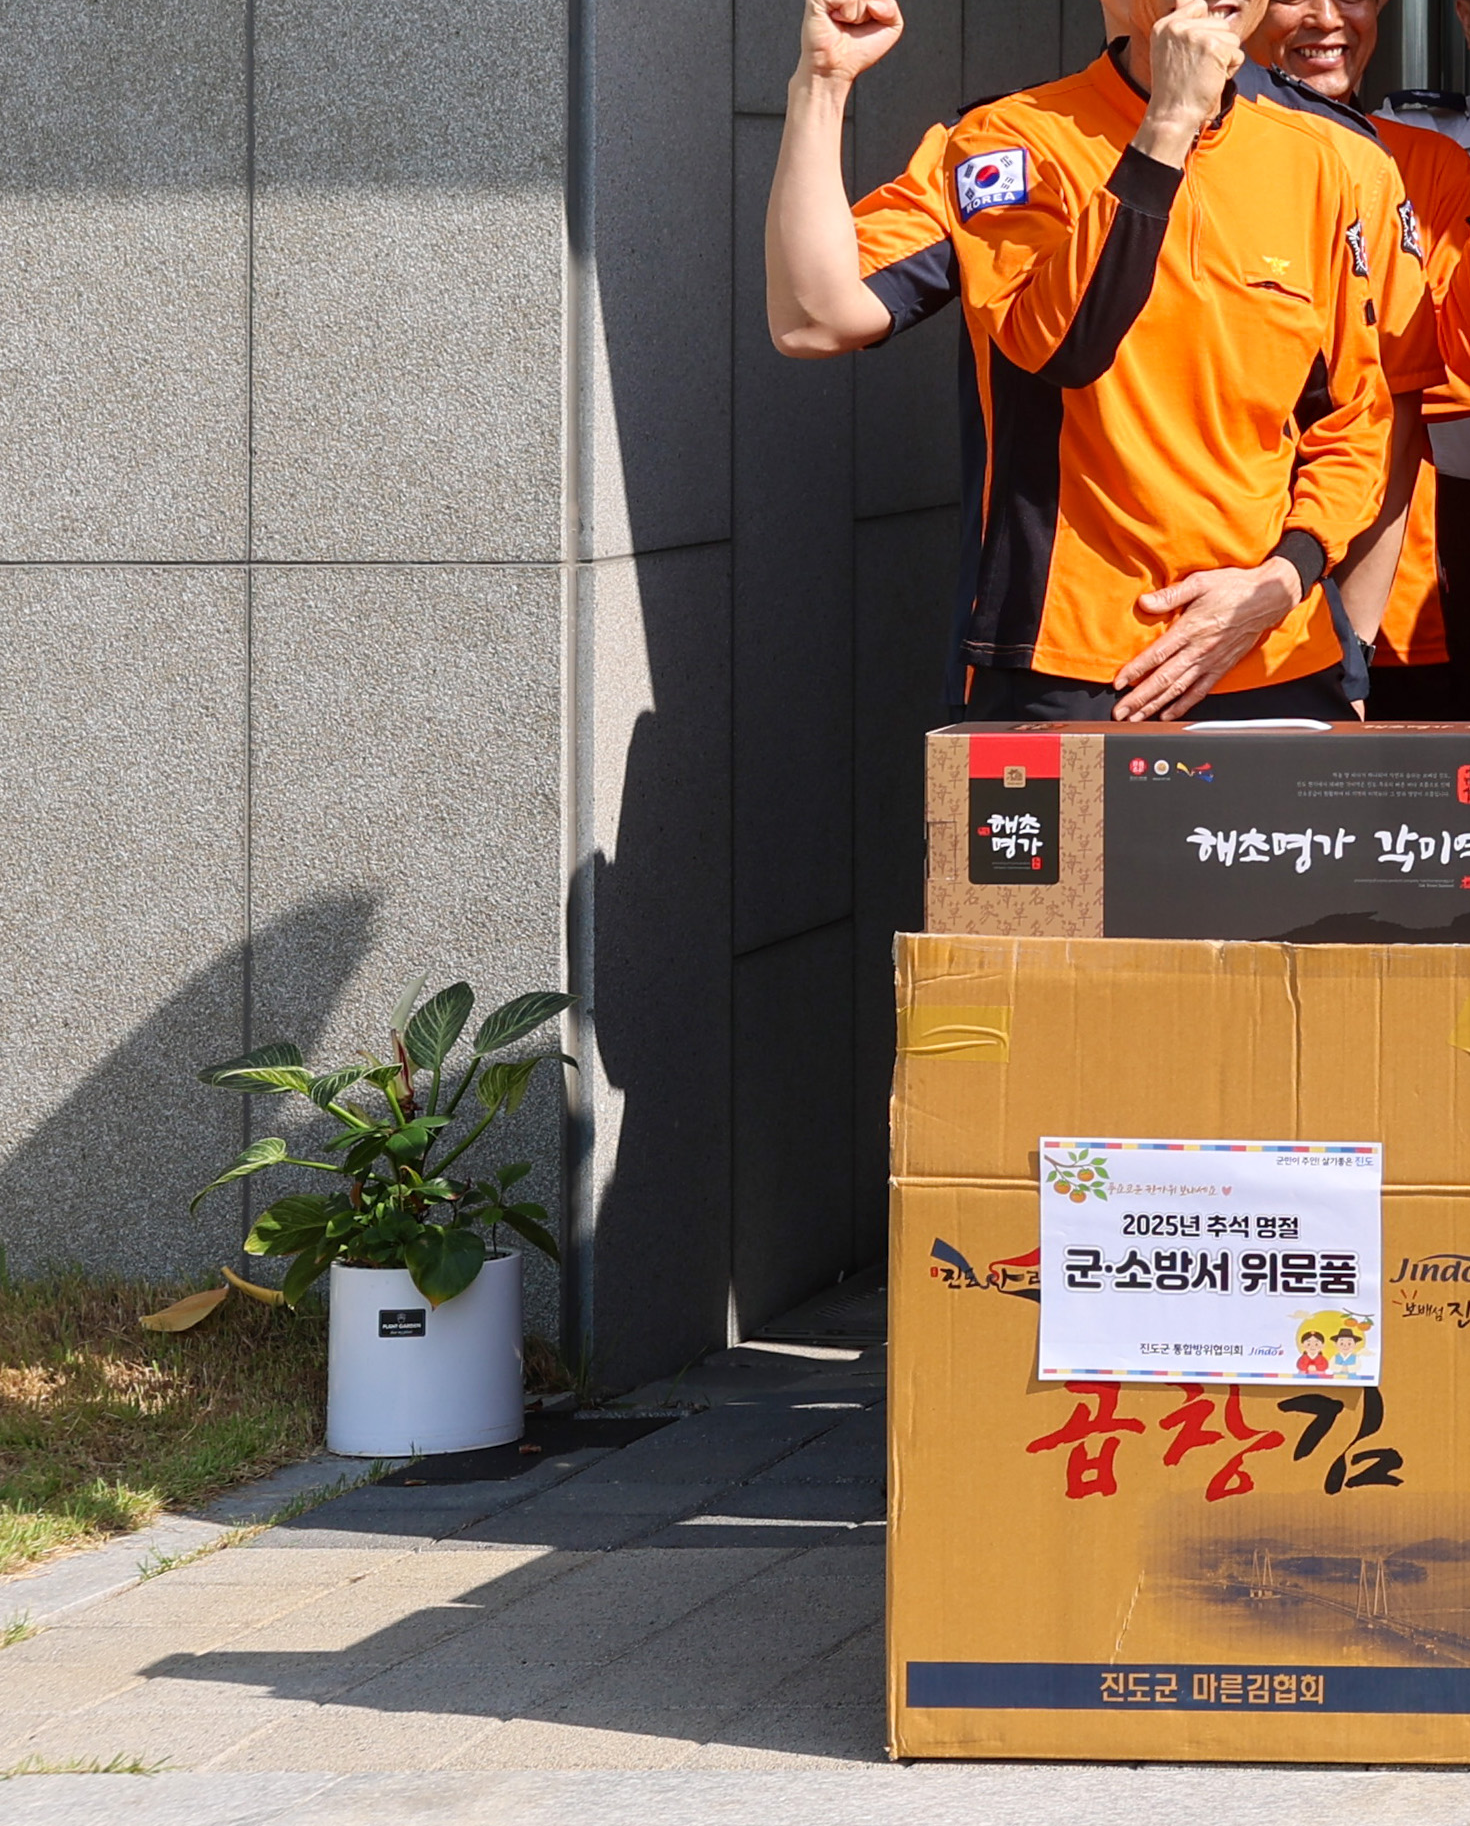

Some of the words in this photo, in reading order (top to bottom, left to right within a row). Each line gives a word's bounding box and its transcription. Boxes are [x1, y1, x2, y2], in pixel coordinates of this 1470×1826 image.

[966, 191, 1016, 213] KOREA
[987, 813, 1041, 835] 해초
[991, 834, 1043, 859] 명가
[1186, 825, 1356, 875] 해초명가
[1355, 1156, 1373, 1167] 진도
[1122, 1213, 1201, 1237] 2025년
[1206, 1215, 1250, 1239] 추석
[1256, 1216, 1300, 1240] 명절
[1065, 1247, 1229, 1292] 군·소방서
[1240, 1252, 1357, 1295] 위문품
[1402, 1302, 1444, 1322] 보배섬
[1139, 1342, 1169, 1355] 진도군
[1172, 1342, 1243, 1357] 통합방위협의회
[1026, 1382, 1405, 1502] 곱창김
[1099, 1671, 1179, 1705] 진도군
[1192, 1672, 1325, 1707] 마른김협회
